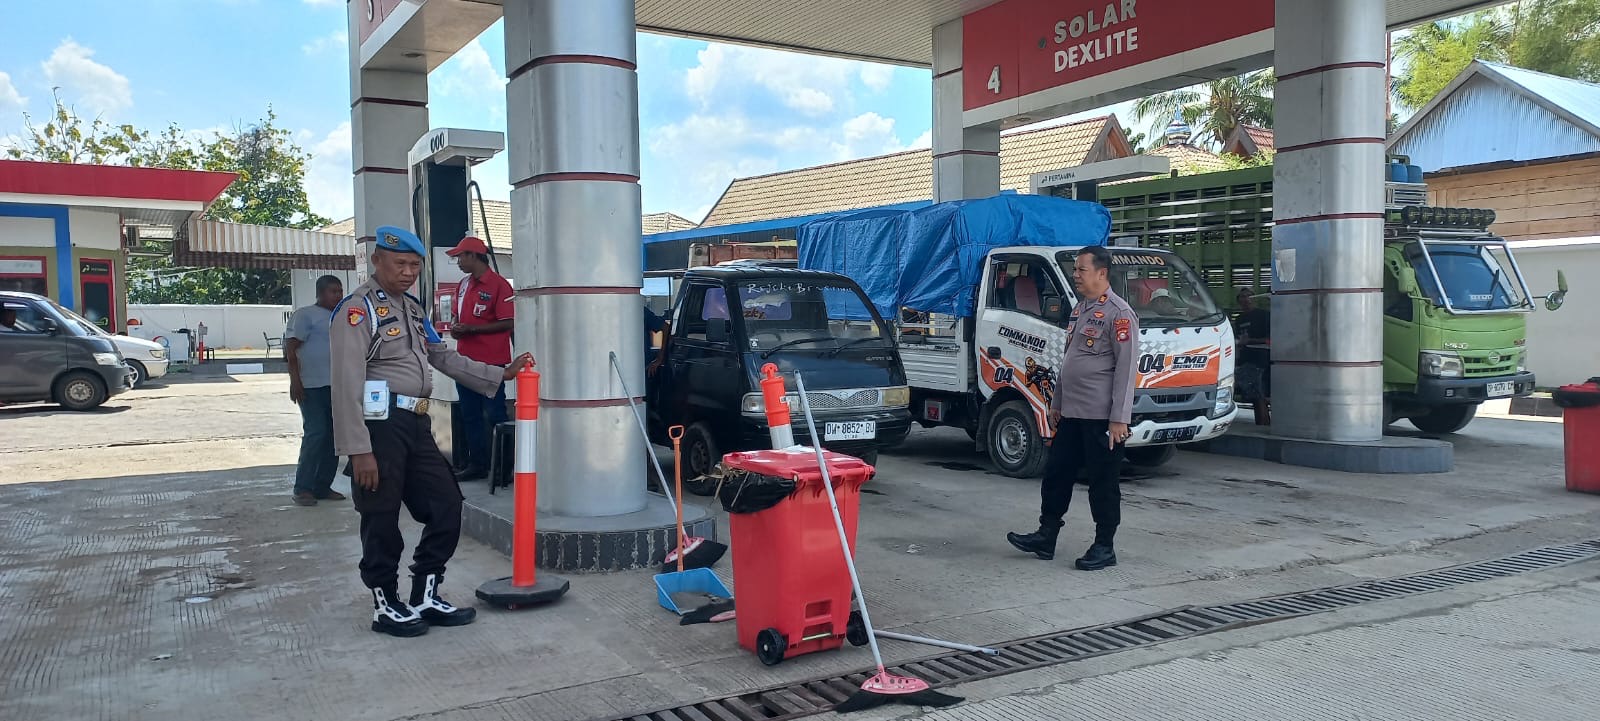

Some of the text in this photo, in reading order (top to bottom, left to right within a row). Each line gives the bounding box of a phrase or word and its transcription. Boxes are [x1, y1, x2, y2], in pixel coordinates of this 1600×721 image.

[1053, 0, 1138, 44] SOLAR
[1053, 27, 1139, 73] DEXLITE
[987, 65, 1001, 94] 4
[1111, 254, 1166, 266] MMANDO
[998, 326, 1047, 349] COMMANDO
[1138, 354, 1166, 373] 04
[994, 367, 1014, 383] 04
[826, 423, 838, 435] DW
